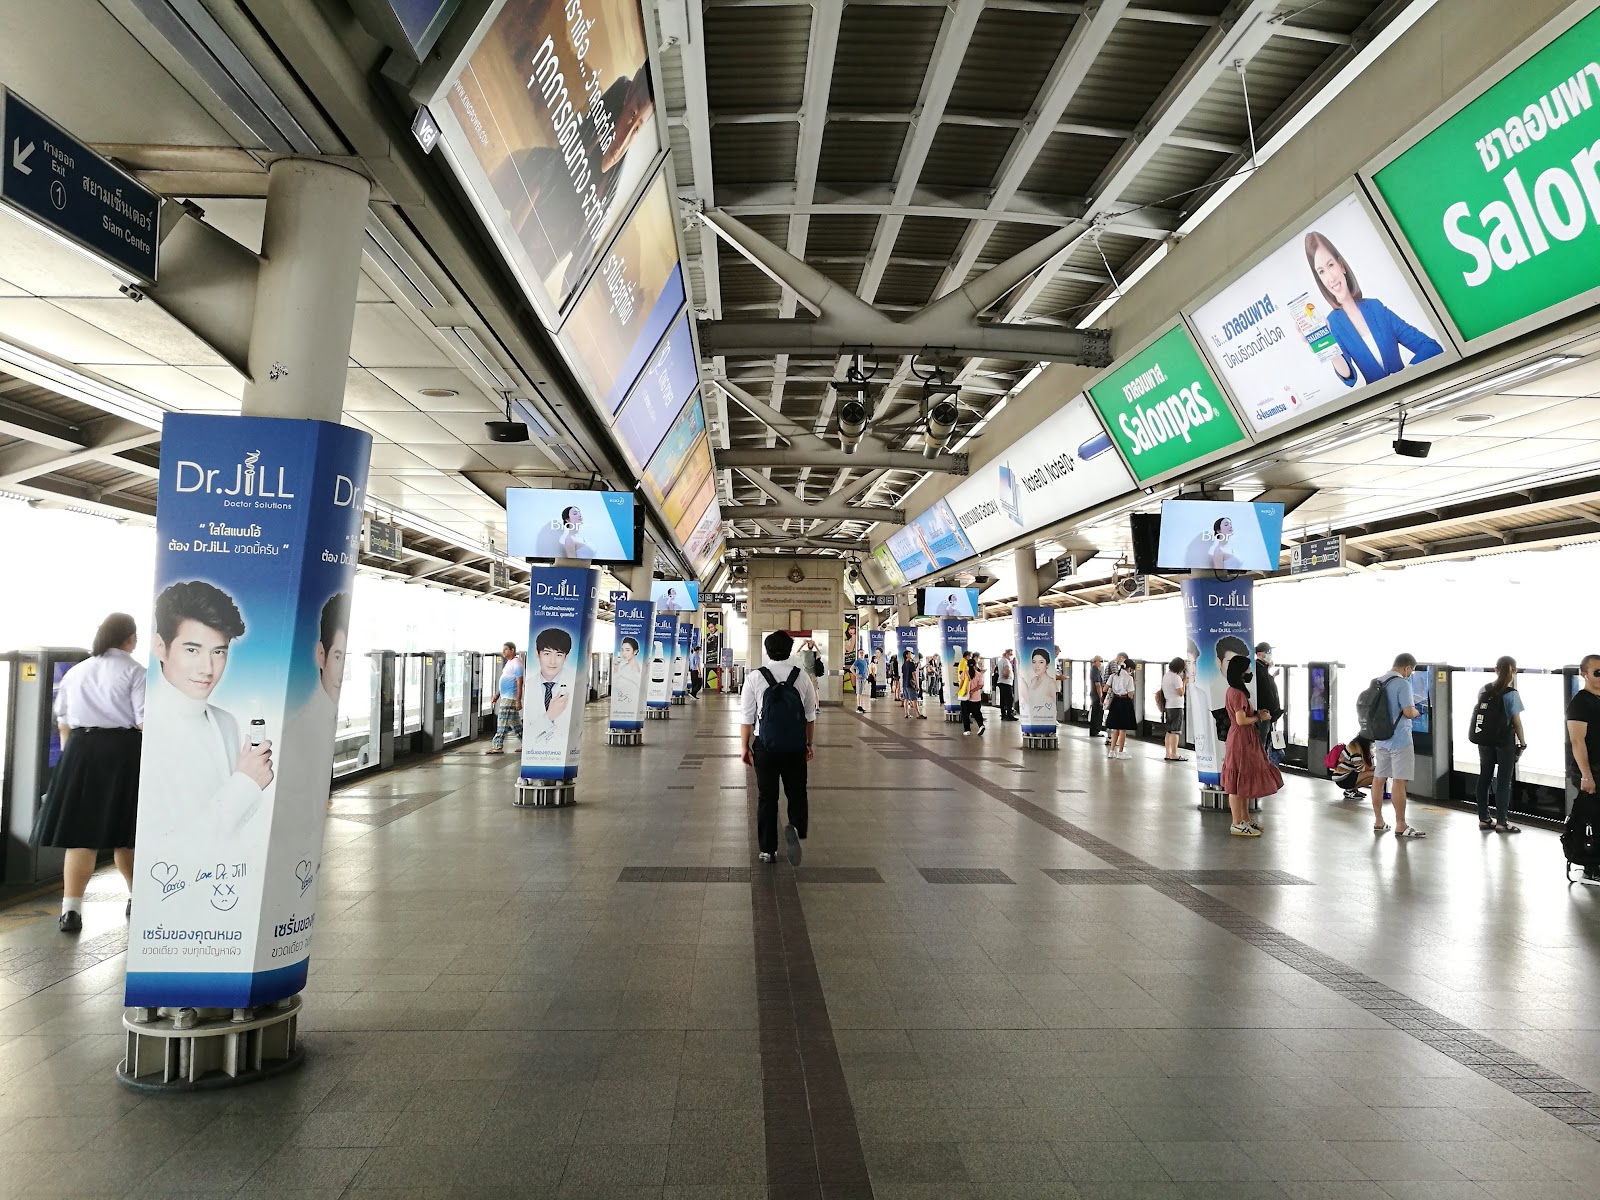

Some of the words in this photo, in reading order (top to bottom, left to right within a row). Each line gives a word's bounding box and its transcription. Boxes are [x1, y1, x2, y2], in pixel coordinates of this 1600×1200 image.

[527, 34, 591, 193] ทุกการเดินทาง
[43, 140, 75, 169] ทางออก
[51, 160, 66, 177] Exit
[82, 176, 153, 231] สยามเซ็นเตอร์
[102, 215, 123, 239] Siam
[125, 229, 151, 254] Centre
[1122, 363, 1166, 403] ซาลอนพาส
[1119, 381, 1213, 455] Salonpas
[1021, 467, 1047, 493] Note10
[1044, 453, 1075, 482] Note10+
[224, 500, 251, 508] Doctor
[255, 500, 292, 509] Solutions
[979, 499, 1001, 518] Galaxy
[169, 539, 190, 552] ต้อง
[234, 541, 279, 555] ขวดนี้ครับ
[321, 549, 338, 563] ต้อง
[195, 869, 212, 882] Love
[216, 863, 228, 880] Dr.
[232, 863, 247, 878] Jill
[143, 923, 242, 944] เซรั่มของคุณหมอ
[142, 945, 178, 955] ขวดเดียว
[182, 945, 242, 957] จบทุกปัญหาผิว
